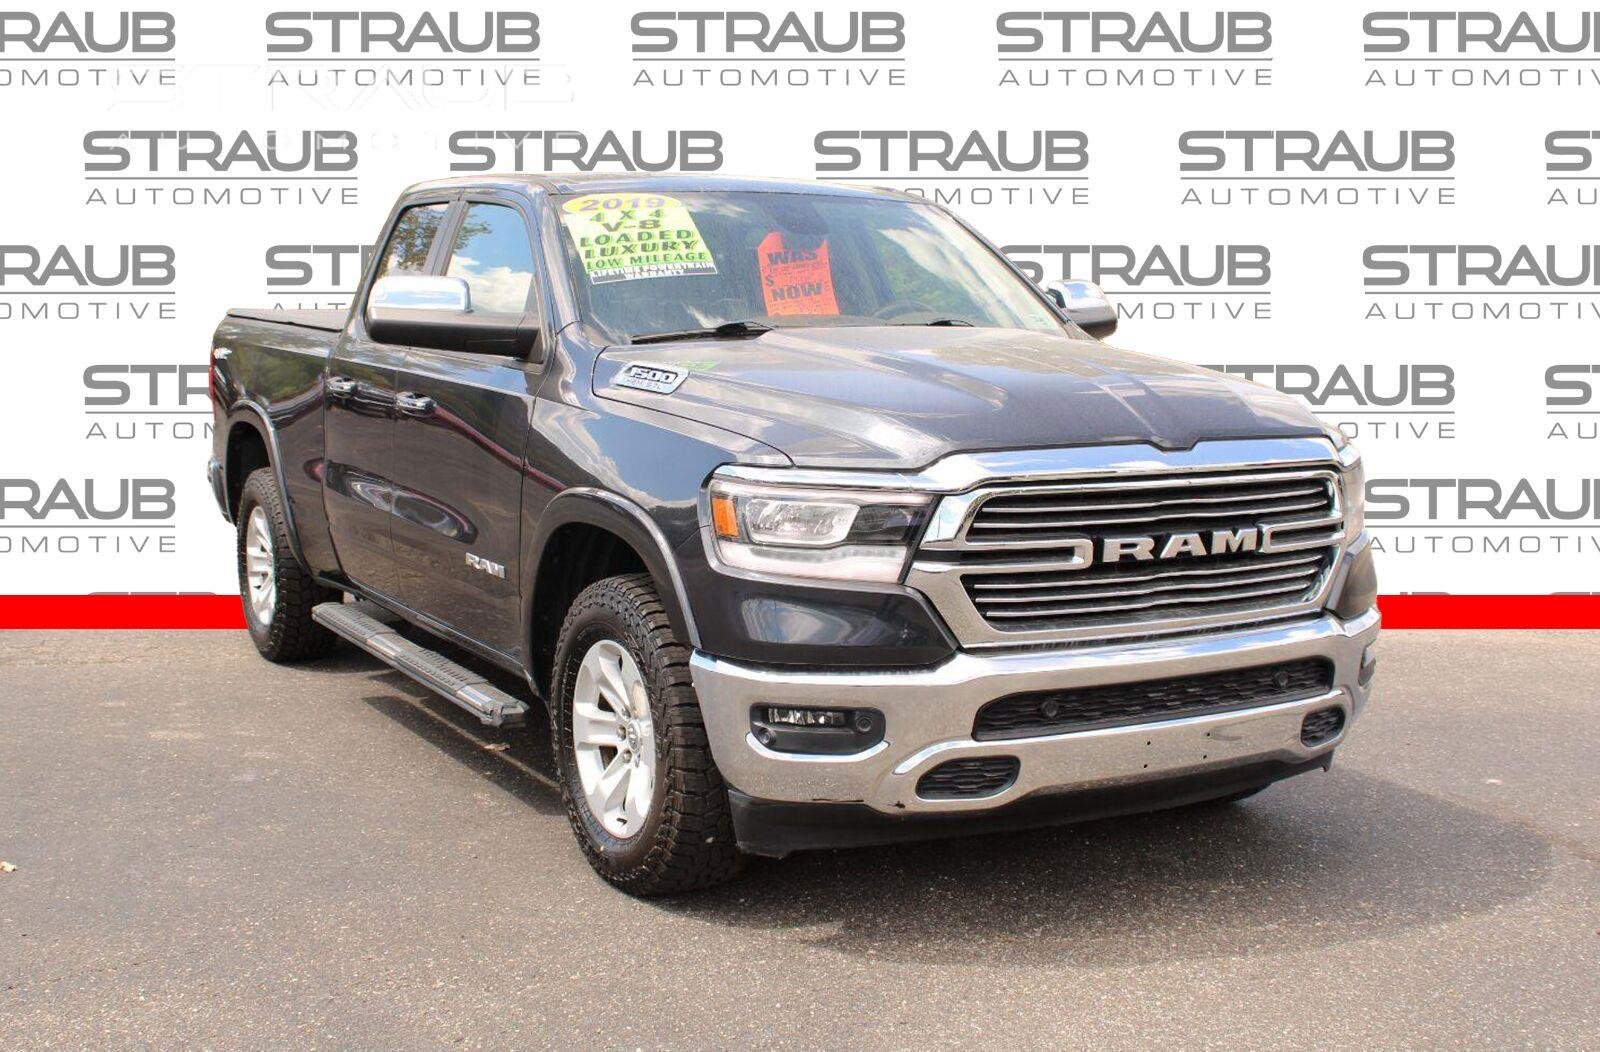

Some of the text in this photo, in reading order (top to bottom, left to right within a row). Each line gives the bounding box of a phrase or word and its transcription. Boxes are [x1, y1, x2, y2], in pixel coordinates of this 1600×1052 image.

[266, 10, 540, 53] STRAUB
[631, 10, 906, 53] STRAUB
[997, 10, 1273, 53] STRAUB
[1363, 10, 1600, 53] STRAU
[267, 68, 541, 86] AUTOMOTIVE
[632, 68, 906, 86] AUTOMOTIVE
[998, 68, 1273, 86] AUTOMOTIVE
[83, 129, 359, 172] STRAUB
[449, 129, 724, 172] STRAUB
[814, 129, 1090, 172] STRAUB
[1179, 129, 1456, 172] STRAUB
[85, 187, 358, 205] AUTOMOTIVE
[580, 197, 665, 211] 2019
[1180, 187, 1456, 205] AUTOMOTIVE
[580, 229, 693, 247] LOADED
[602, 219, 661, 232] V-8
[584, 240, 697, 259] LUXURY
[587, 252, 706, 270] LOW MILEAGE
[1363, 244, 1600, 287] STRAU
[772, 281, 823, 302] NOW
[630, 367, 677, 383] 1500
[1197, 364, 1456, 407] TRAUB
[1364, 477, 1600, 521] STRAU
[1102, 527, 1258, 563] RAM
[466, 552, 505, 579] RAM
